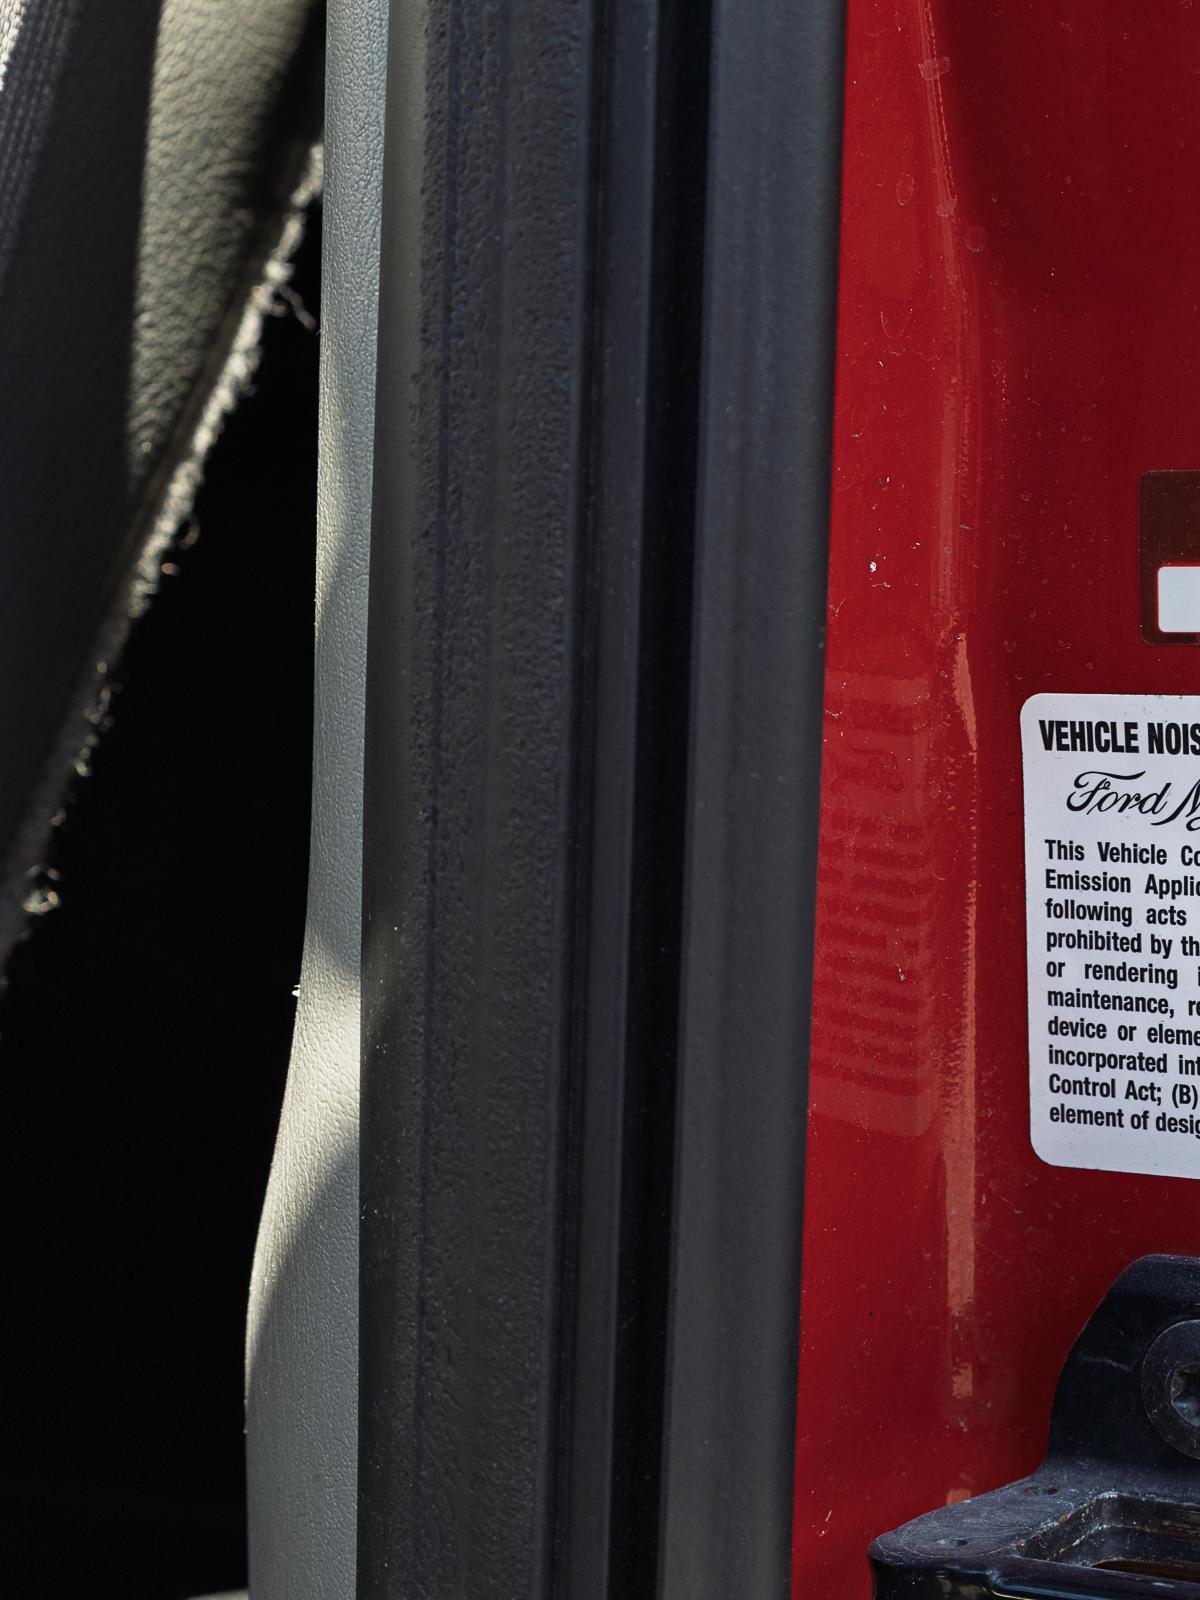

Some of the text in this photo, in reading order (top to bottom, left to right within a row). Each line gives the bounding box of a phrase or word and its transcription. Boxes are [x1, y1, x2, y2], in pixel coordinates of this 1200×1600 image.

[1038, 720, 1140, 754] VEHICLE
[1066, 770, 1172, 815] Ford
[1045, 839, 1084, 861] This
[1097, 842, 1167, 865] Vehicle
[1046, 869, 1130, 893] Emission
[1045, 898, 1132, 927] following
[1146, 906, 1186, 926] acts
[1047, 929, 1142, 953] prohibited
[1151, 934, 1172, 959] by
[1047, 961, 1065, 977] or
[1085, 962, 1177, 989] rendering
[1048, 988, 1174, 1018] maintenance,
[1048, 1016, 1107, 1039] device
[1118, 1025, 1137, 1041] or
[1049, 1044, 1167, 1073] incorporated
[1049, 1074, 1116, 1098] Control
[1125, 1080, 1161, 1106] Act;
[1172, 1084, 1198, 1110] (B)
[1050, 1103, 1124, 1128] element
[1130, 1110, 1149, 1130] of
